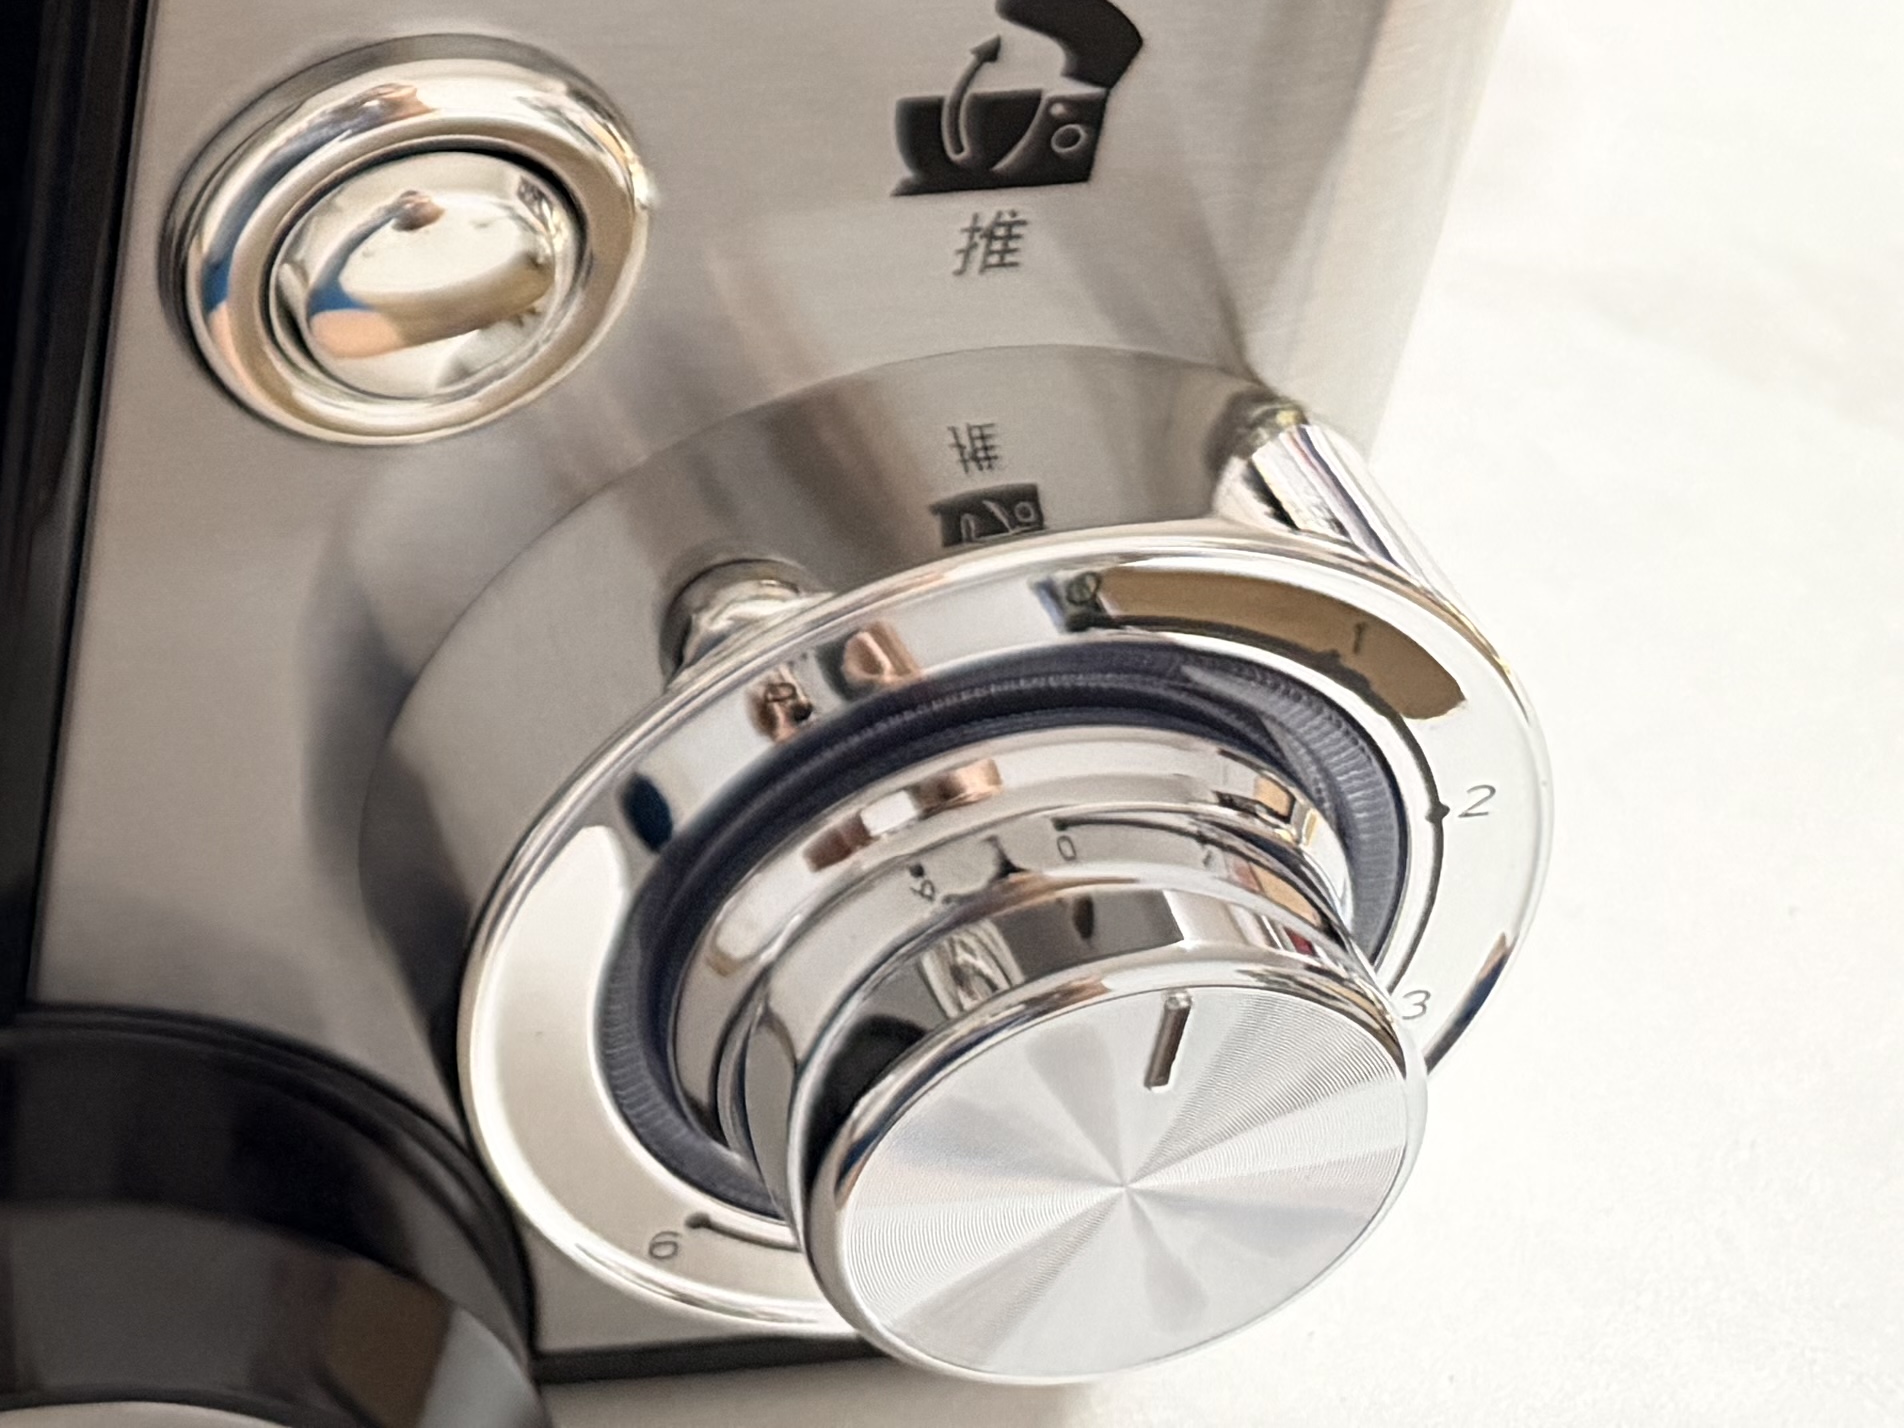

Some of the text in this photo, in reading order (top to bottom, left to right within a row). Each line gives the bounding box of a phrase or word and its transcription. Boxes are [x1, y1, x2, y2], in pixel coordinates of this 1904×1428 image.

[951, 209, 1029, 277] 推
[1352, 621, 1367, 655] 1
[1457, 783, 1497, 819] 2
[1401, 989, 1432, 1021] 3
[648, 1229, 683, 1260] 6
